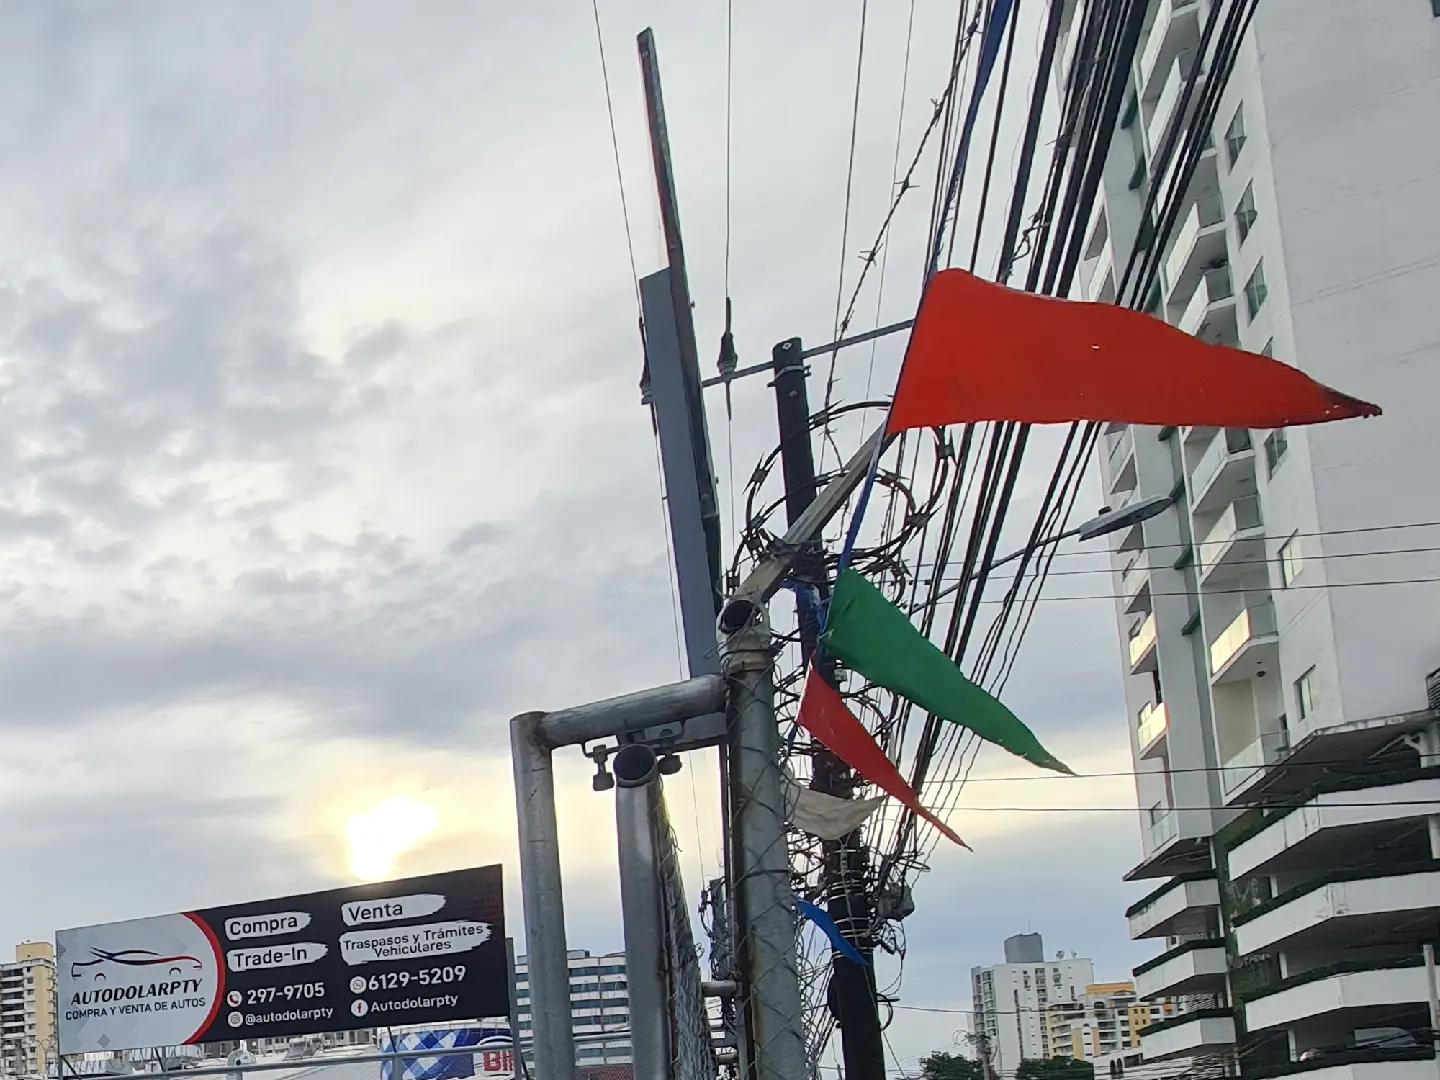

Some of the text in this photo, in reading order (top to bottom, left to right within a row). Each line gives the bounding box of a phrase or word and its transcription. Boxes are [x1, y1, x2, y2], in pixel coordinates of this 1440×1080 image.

[348, 904, 403, 921] Venta
[230, 916, 298, 935] Compra
[343, 934, 409, 950] Traspasos
[412, 933, 420, 944] y
[374, 940, 452, 958] Vehiculares
[233, 947, 307, 968] Trade-In
[368, 965, 466, 990] 6129-5209
[71, 978, 203, 1006] AUTODOLARPTY
[247, 982, 325, 1004] 297-9705
[65, 997, 206, 1020] COMPRA Y VENTA DE AUTOS
[370, 994, 459, 1013] Autodolarpty
[245, 1007, 334, 1026] @autodolarpty
